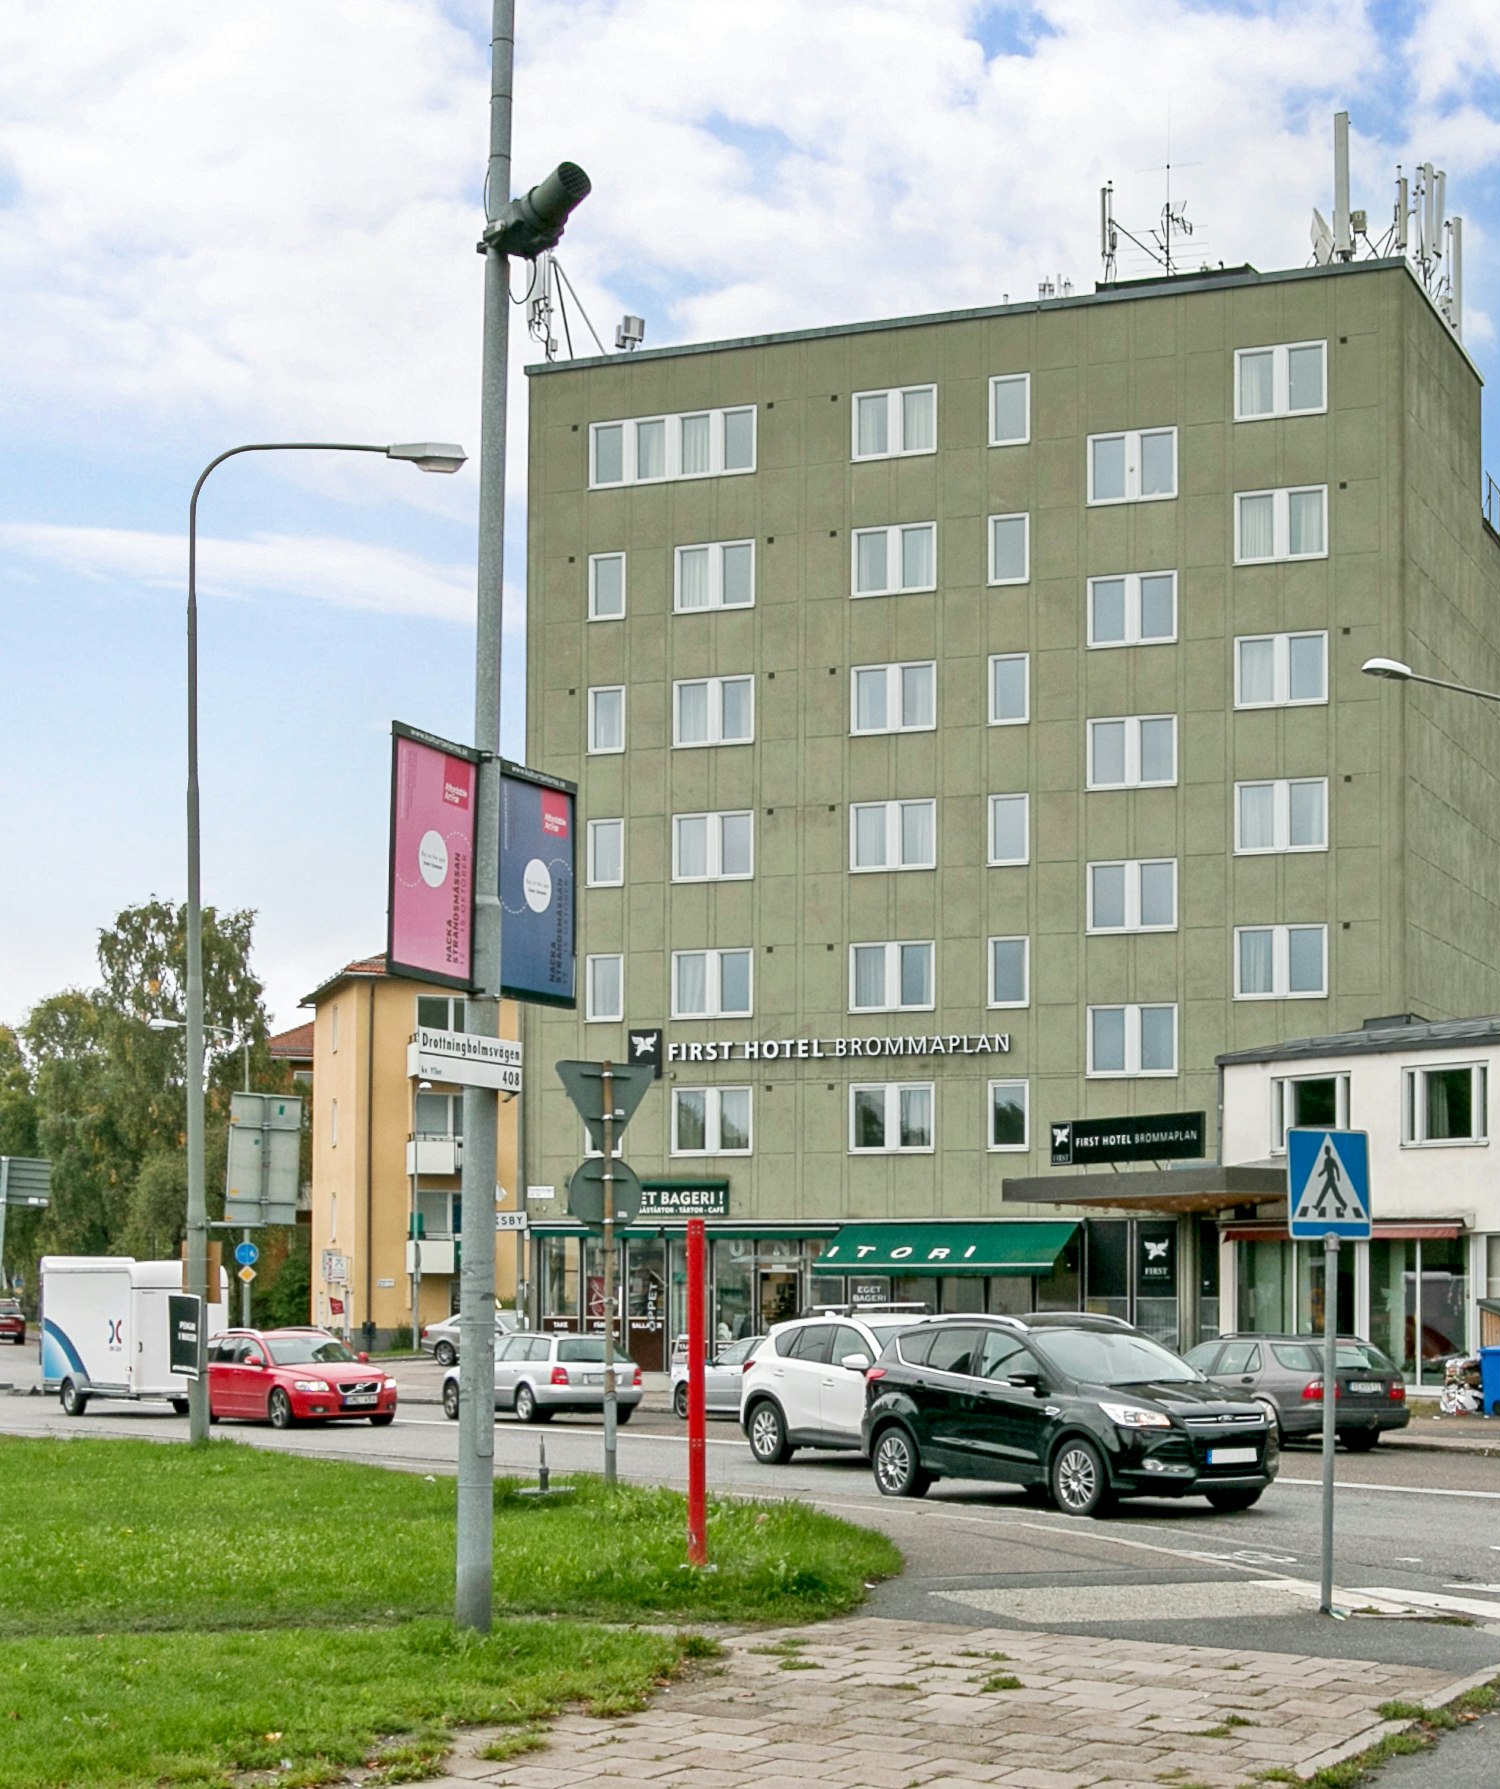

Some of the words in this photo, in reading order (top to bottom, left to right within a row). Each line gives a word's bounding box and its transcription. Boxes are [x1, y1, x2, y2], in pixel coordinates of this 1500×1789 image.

[422, 1032, 520, 1063] Drottningholmsvägen
[668, 1040, 733, 1062] FIRST
[744, 1038, 824, 1060] HOTEL
[835, 1033, 1011, 1057] BROMMAPLAN
[502, 1070, 520, 1087] 408
[1075, 1136, 1100, 1148] FIRST
[1102, 1134, 1131, 1146] HOTEL
[1134, 1130, 1198, 1144] BROMMAPLAN
[1052, 1153, 1070, 1162] FIRST
[641, 1191, 657, 1205] ET
[661, 1191, 715, 1205] BAGERI
[1144, 1267, 1168, 1275] FIRST
[857, 1285, 882, 1294] EGET
[852, 1294, 887, 1303] BAGERI
